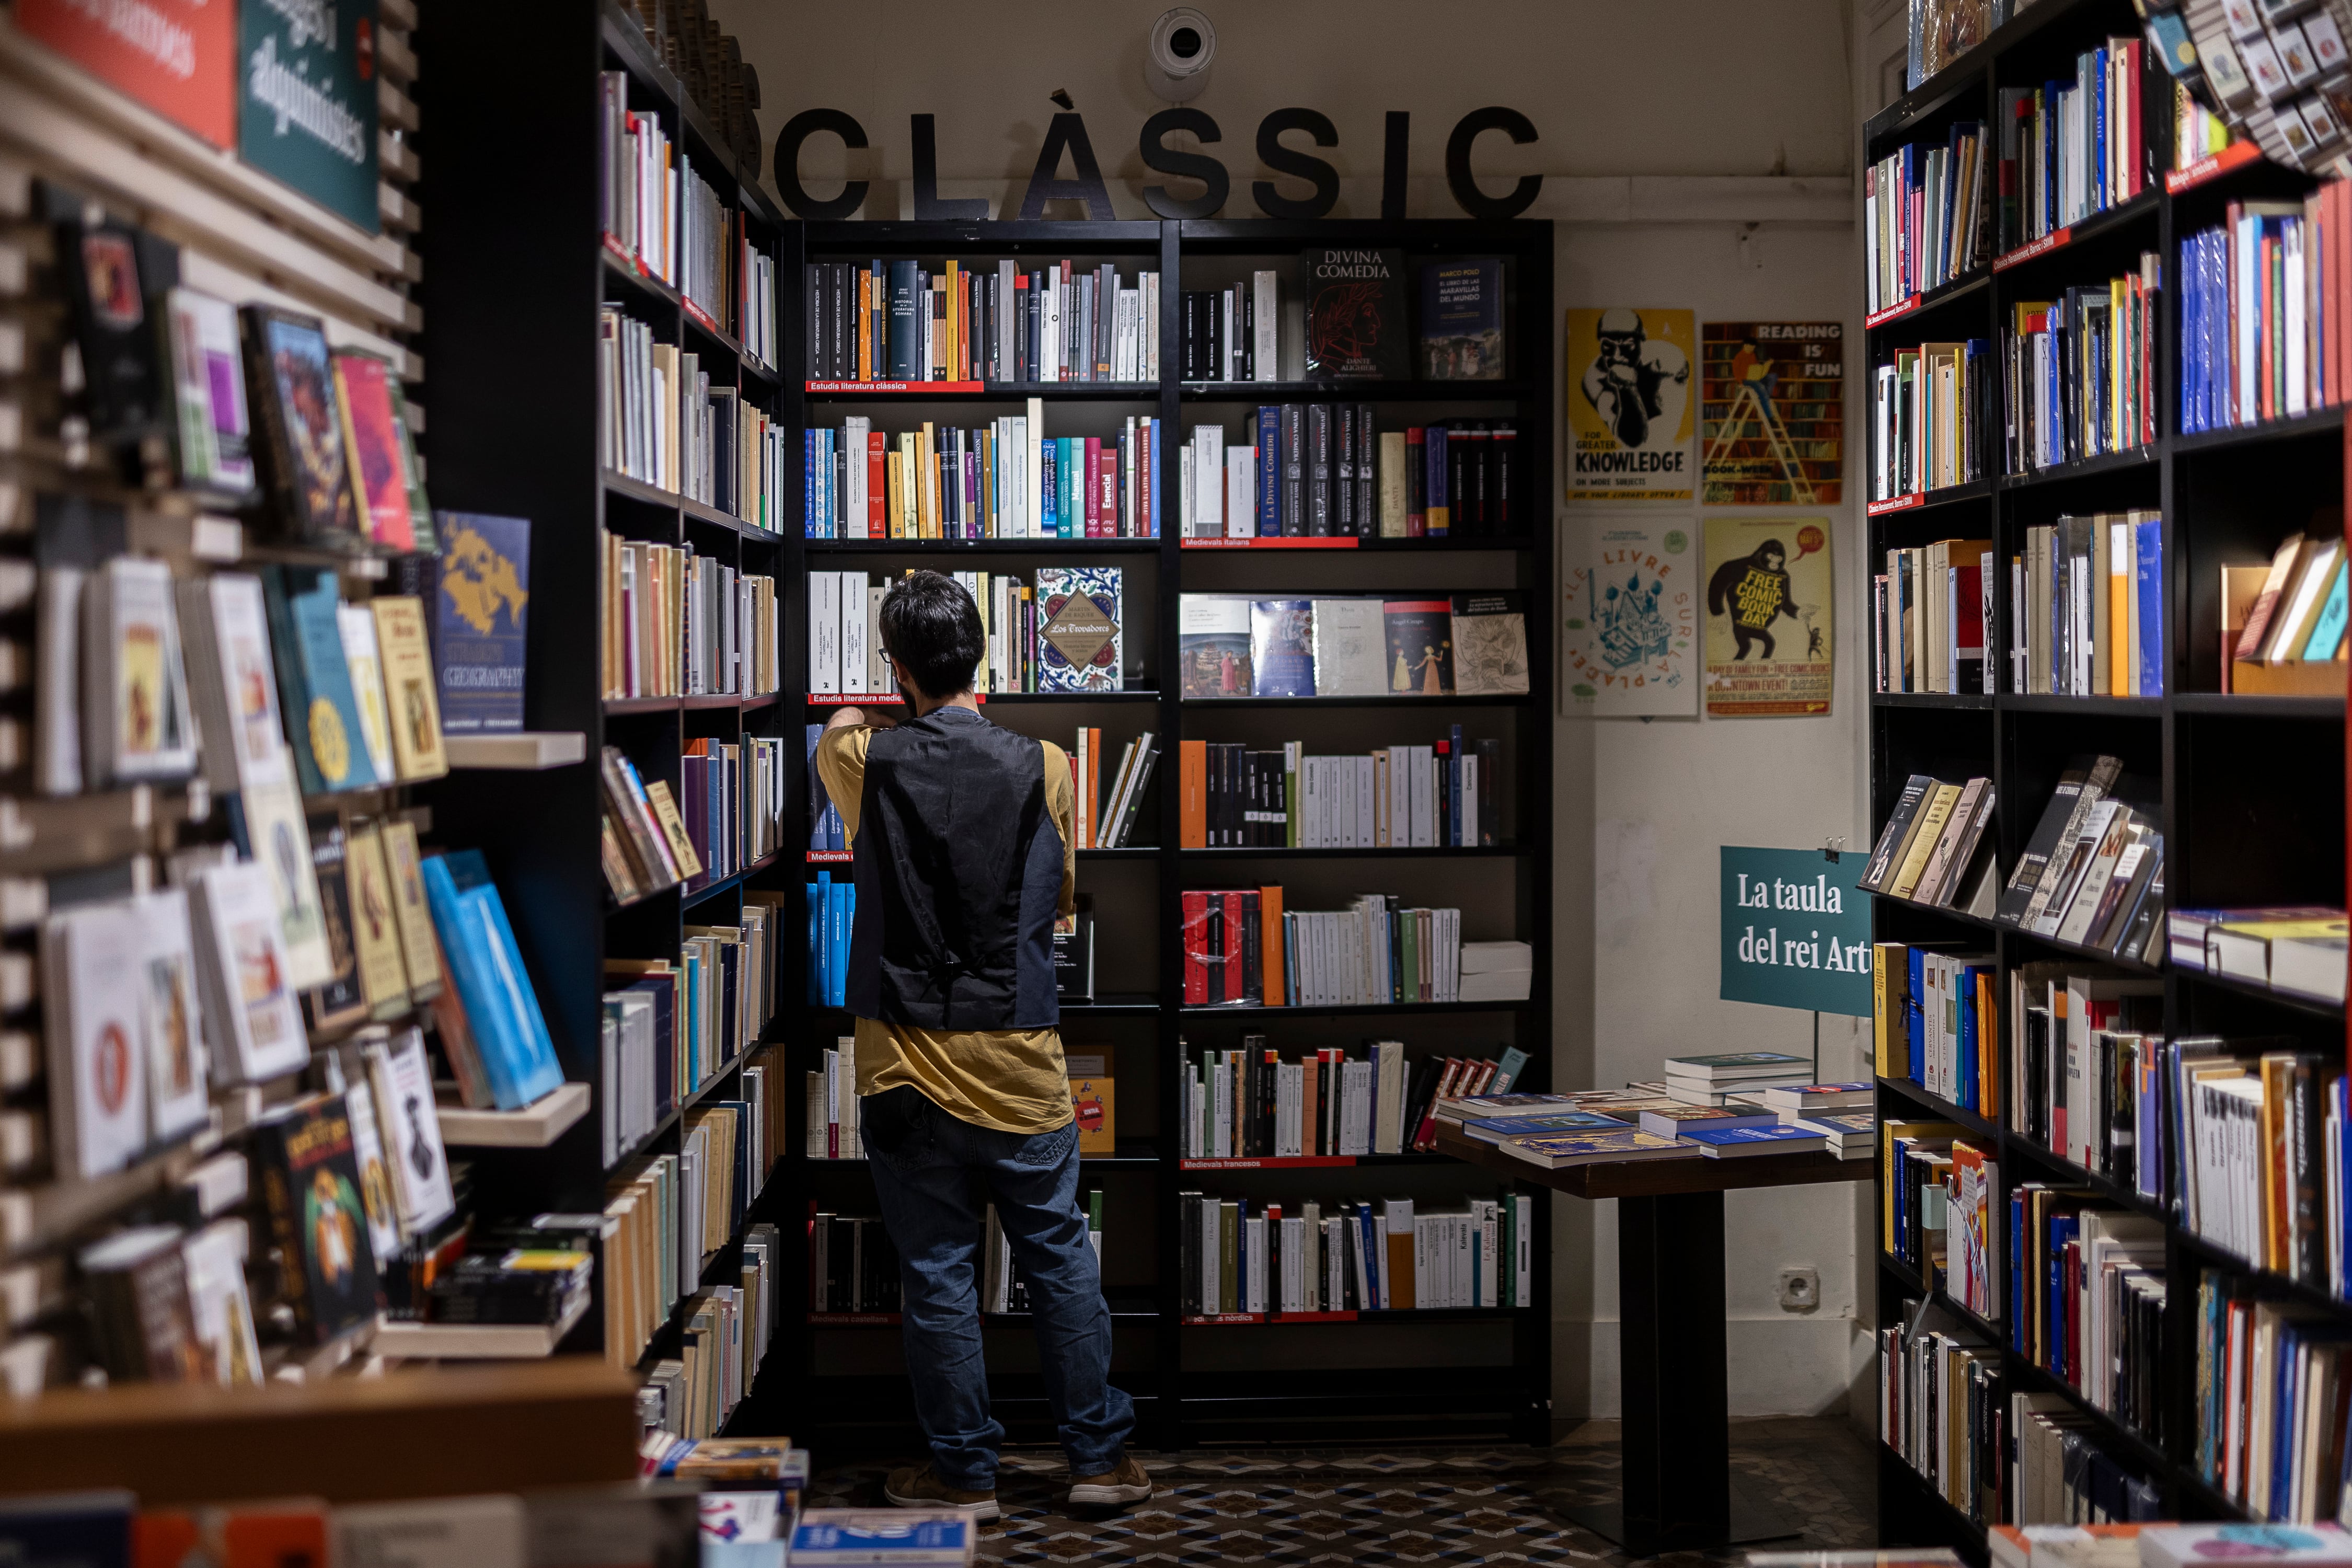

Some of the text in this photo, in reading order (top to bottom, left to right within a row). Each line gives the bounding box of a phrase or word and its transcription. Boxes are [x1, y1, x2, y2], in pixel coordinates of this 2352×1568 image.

[774, 87, 1544, 221] CLÀSSIC
[1324, 250, 1382, 263] DIVINA
[1316, 265, 1390, 278] COMEDIA
[1439, 286, 1480, 294] MARAVILLAS
[1758, 326, 1840, 339] READING
[1805, 344, 1821, 358] IS
[1805, 363, 1841, 376] FUN
[1576, 441, 1616, 449] GREATER
[1576, 452, 1684, 472] KNOWLEDGE
[1103, 474, 1111, 509] Esencial
[1746, 570, 1783, 591] FREE
[1604, 549, 1671, 578] LIVRE
[1674, 592, 1692, 638] SUR
[1735, 581, 1783, 605] COMIC
[1737, 597, 1775, 616] BOOK
[1050, 623, 1109, 633] Los Trovadores
[1743, 610, 1769, 627] DAY
[1103, 812, 1112, 831] TRATADO
[1737, 873, 1843, 914] La taula
[1739, 926, 1778, 965] del
[1784, 930, 1820, 969] rei
